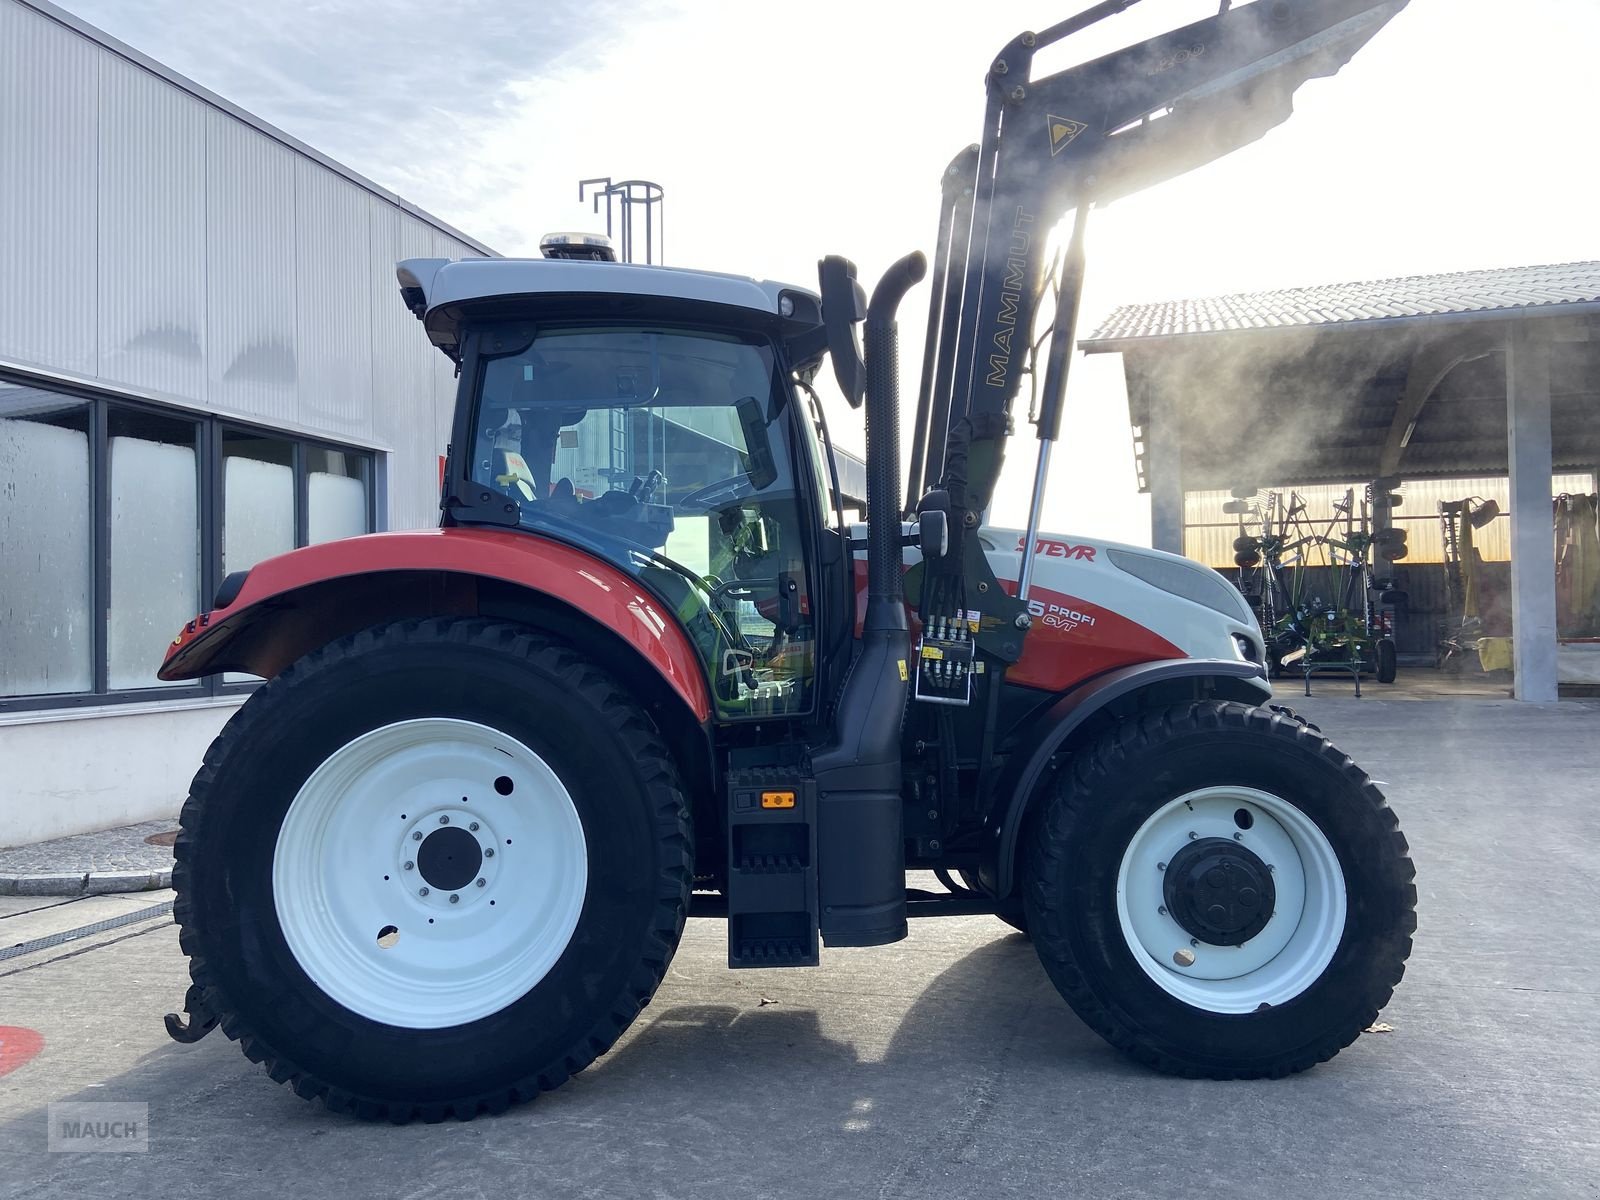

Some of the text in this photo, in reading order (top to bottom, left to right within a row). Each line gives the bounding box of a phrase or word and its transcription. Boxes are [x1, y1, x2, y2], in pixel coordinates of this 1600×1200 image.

[986, 205, 1034, 387] MAMMUT
[1042, 613, 1078, 632] CVT
[1048, 604, 1096, 626] PROFI
